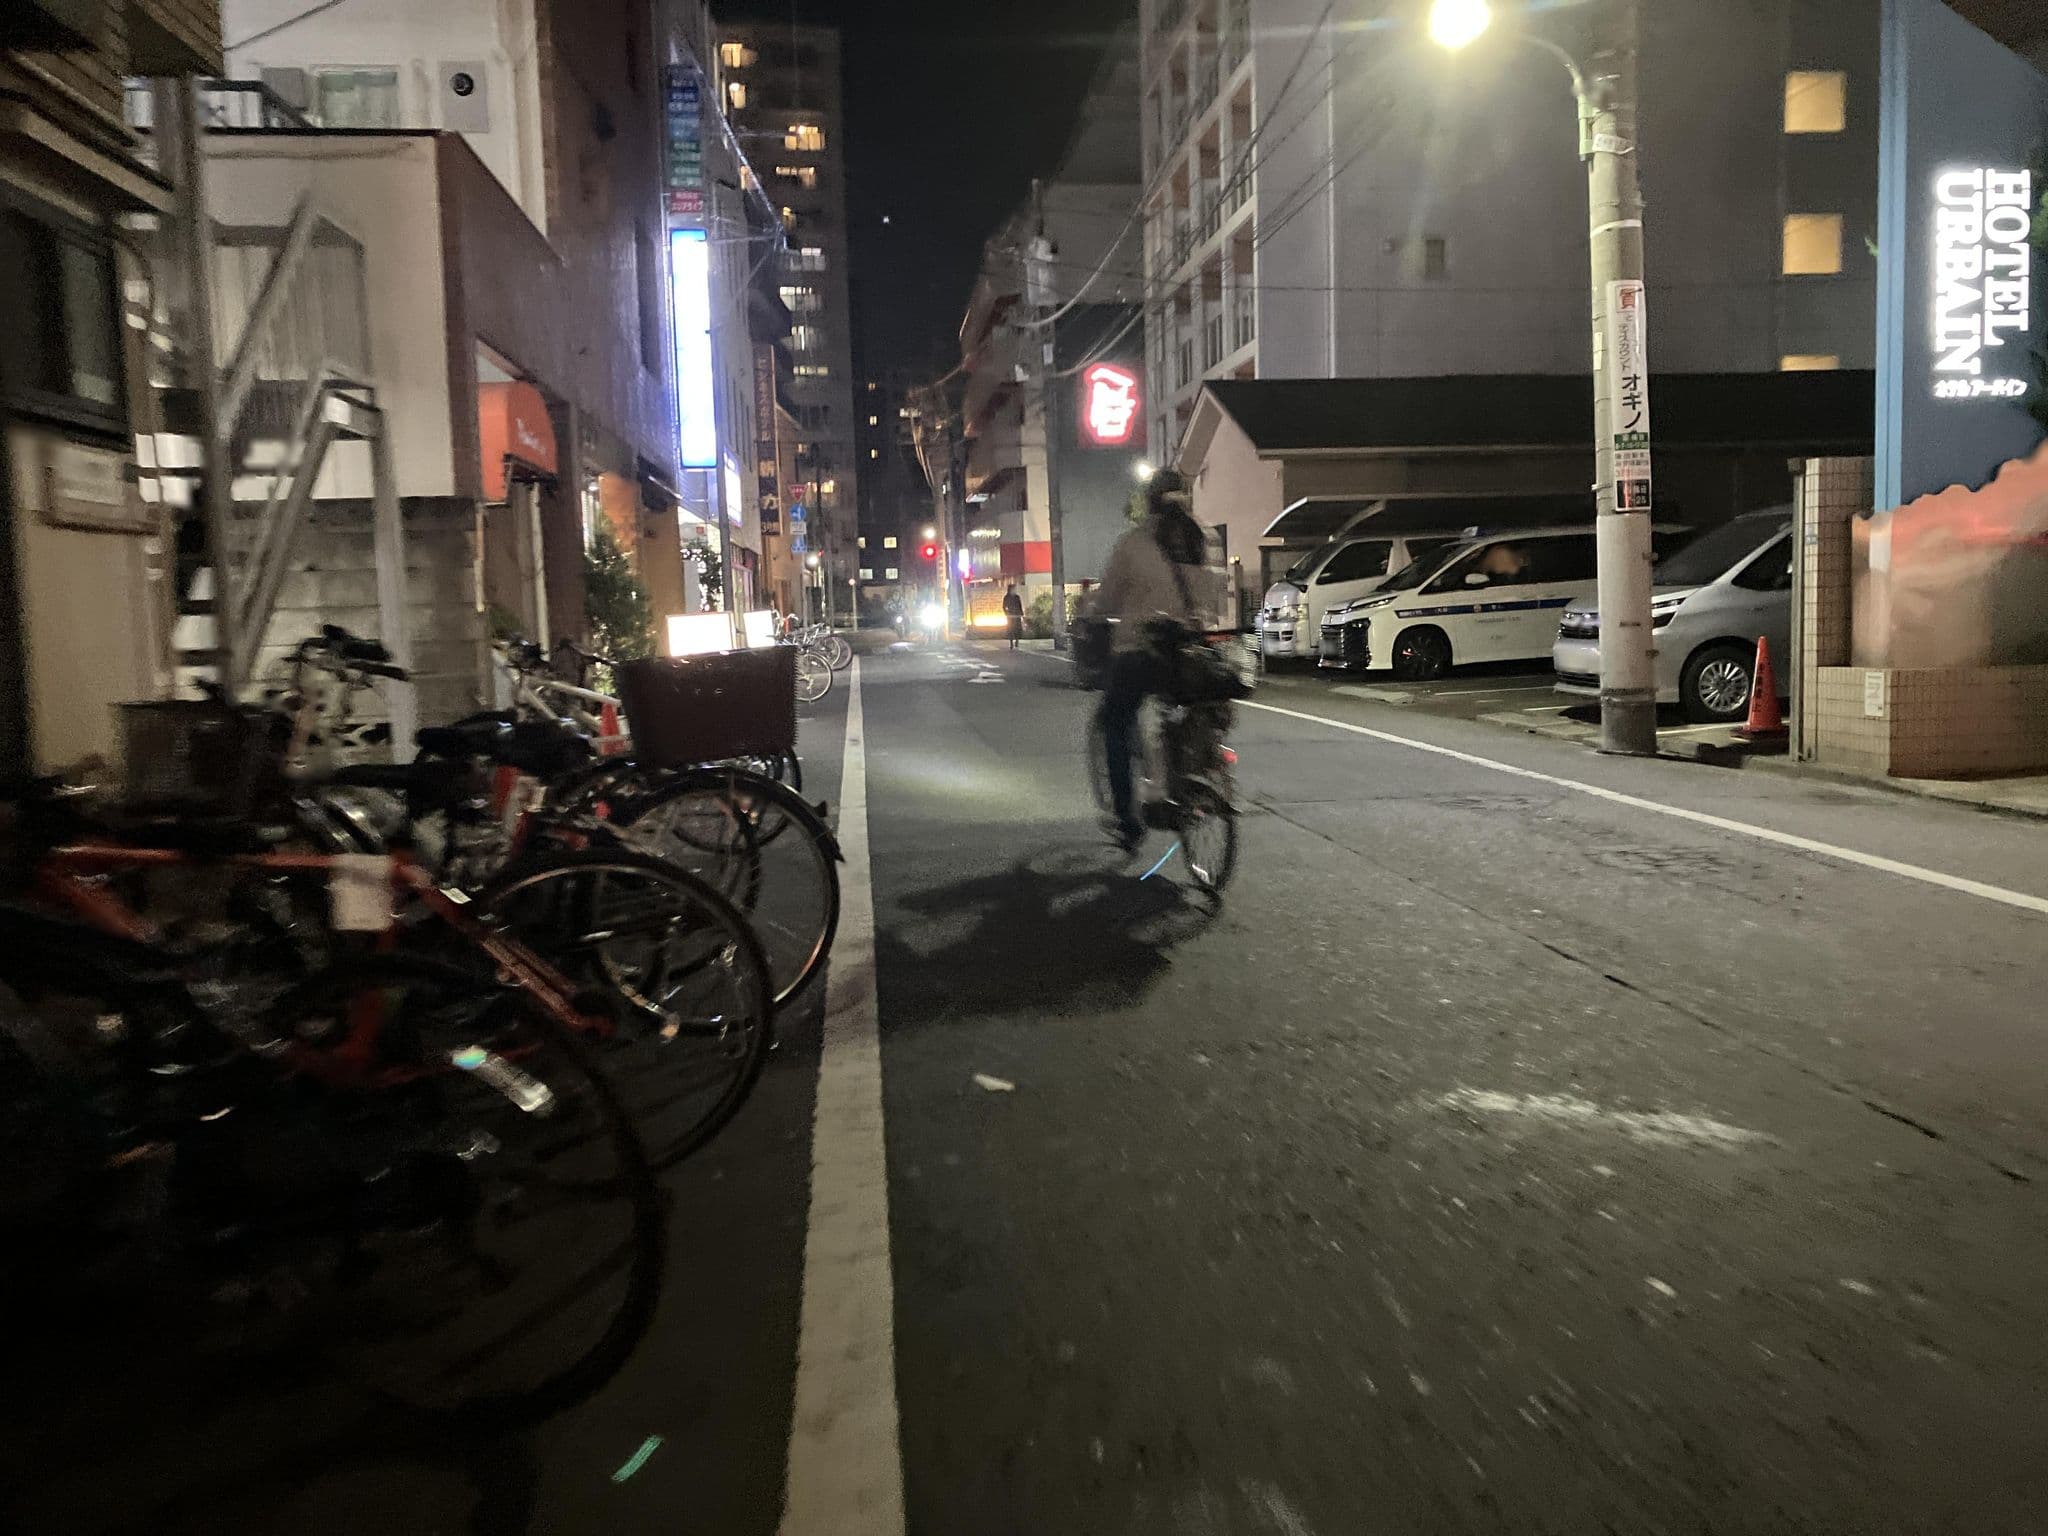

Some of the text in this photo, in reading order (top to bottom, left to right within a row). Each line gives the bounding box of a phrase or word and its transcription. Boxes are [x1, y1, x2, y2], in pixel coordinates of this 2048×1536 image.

[1936, 168, 1982, 375] URBAIN
[1984, 168, 2031, 346] HOTEL
[1621, 374, 1643, 429] オギノ
